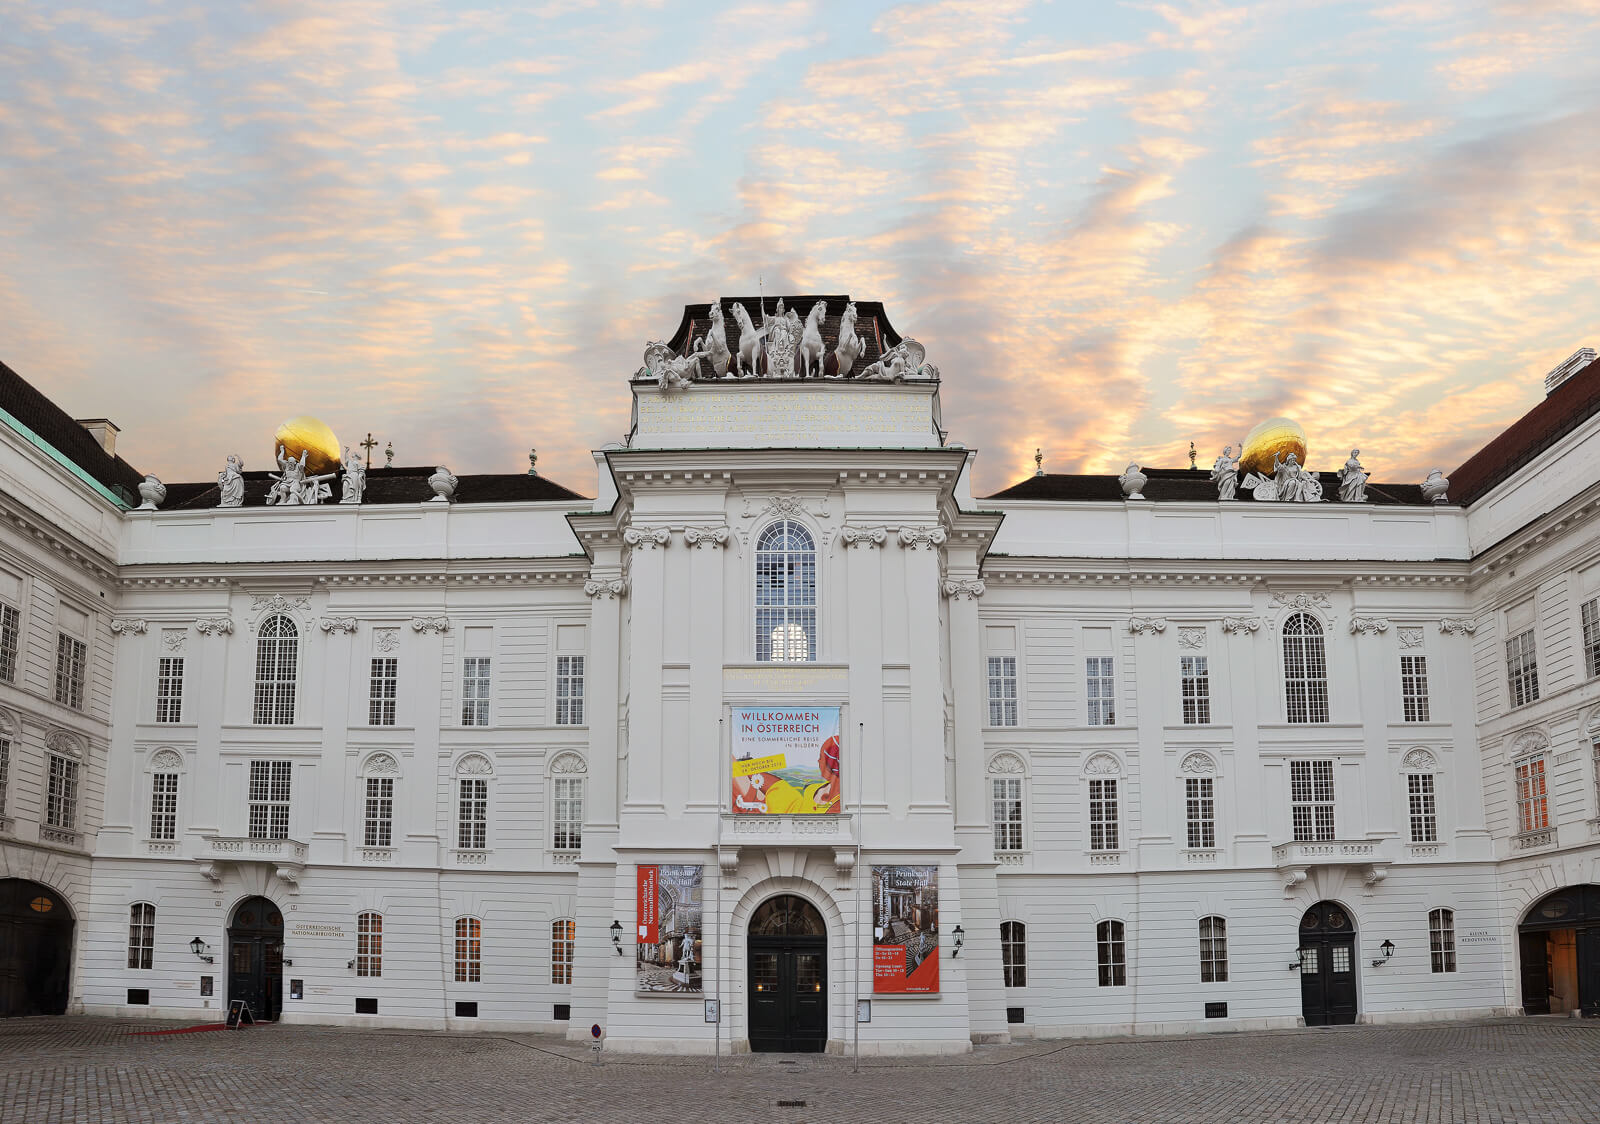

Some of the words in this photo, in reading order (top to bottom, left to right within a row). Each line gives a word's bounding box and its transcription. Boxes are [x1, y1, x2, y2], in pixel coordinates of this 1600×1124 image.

[741, 712, 819, 721] WILLKOMMEN
[741, 724, 753, 733] IN
[757, 722, 820, 733] ÖSTERREICH
